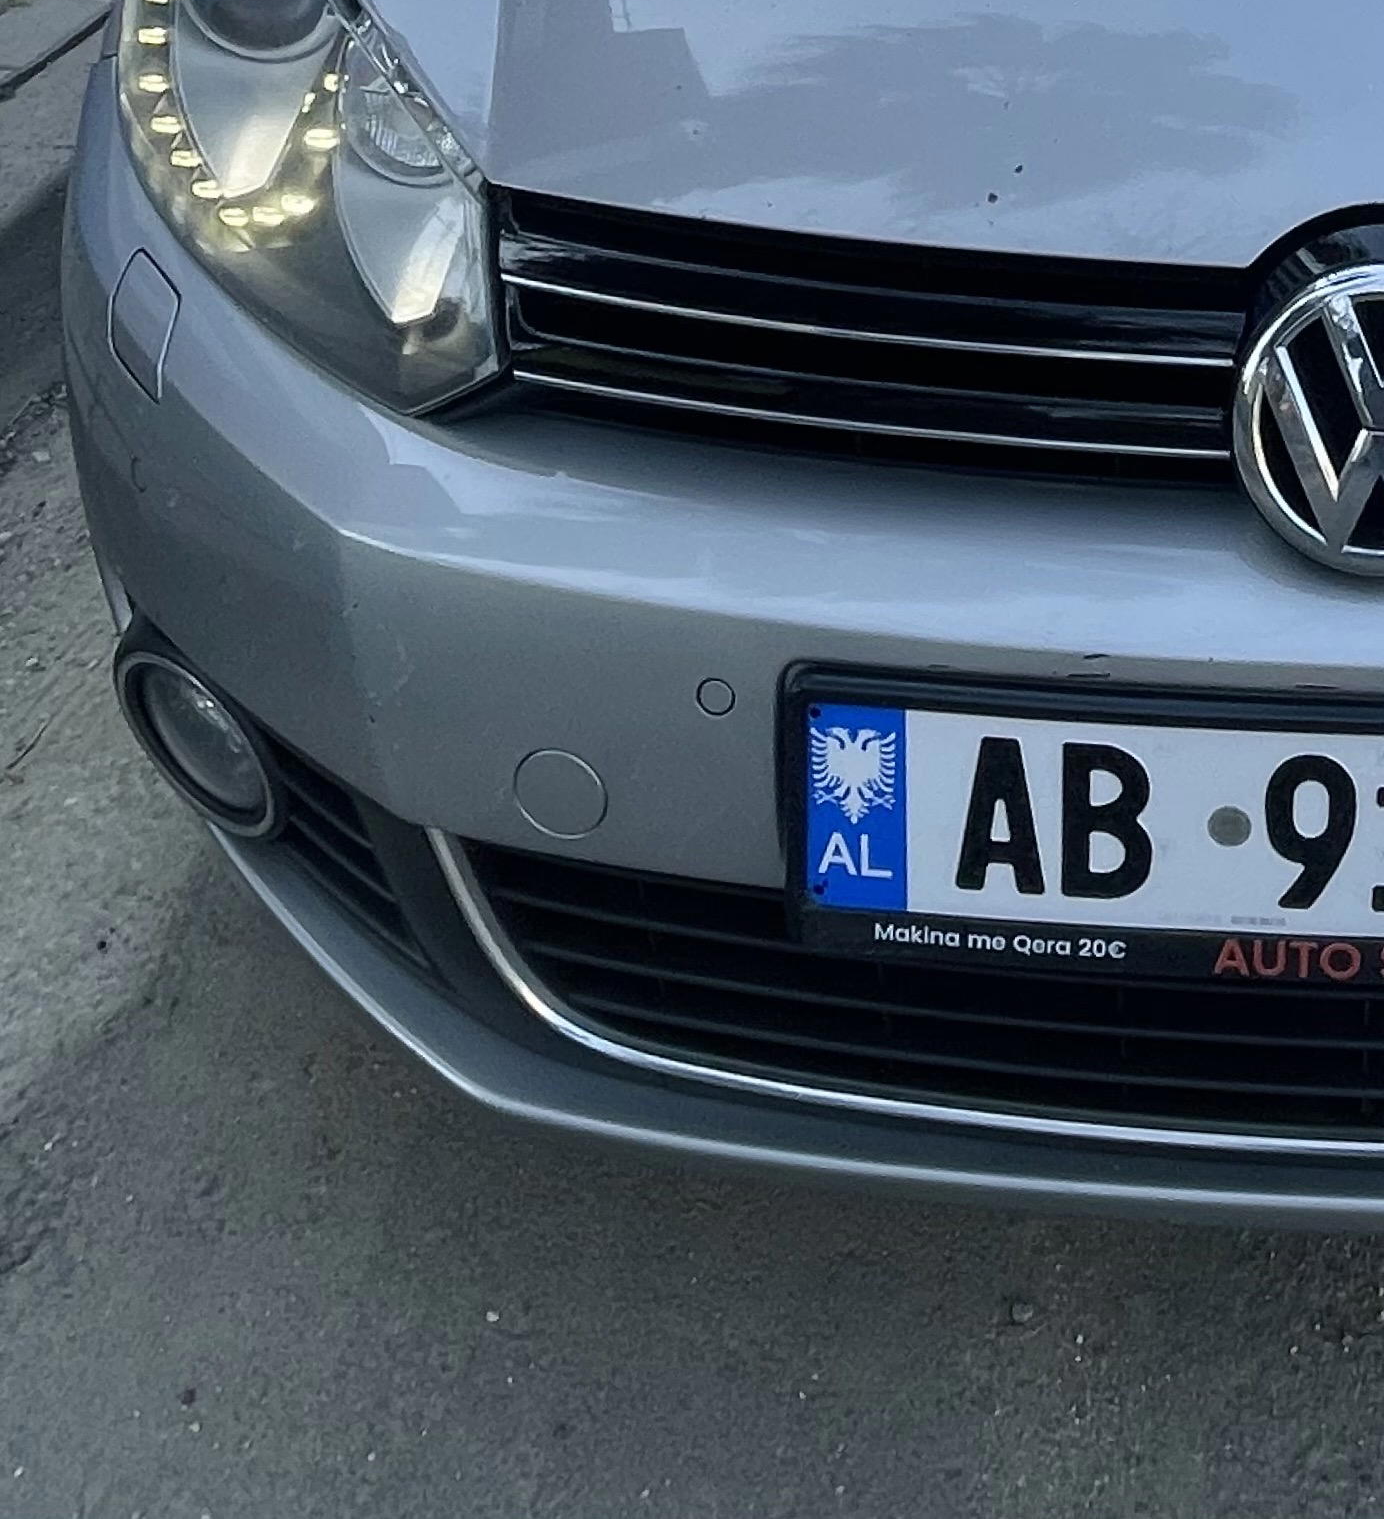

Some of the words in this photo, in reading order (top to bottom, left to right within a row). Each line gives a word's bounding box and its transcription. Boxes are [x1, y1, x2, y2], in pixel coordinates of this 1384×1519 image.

[953, 734, 1153, 900] AB
[818, 831, 893, 879] AL
[1077, 938, 1127, 960] 20€
[1213, 937, 1362, 980] AUTO
